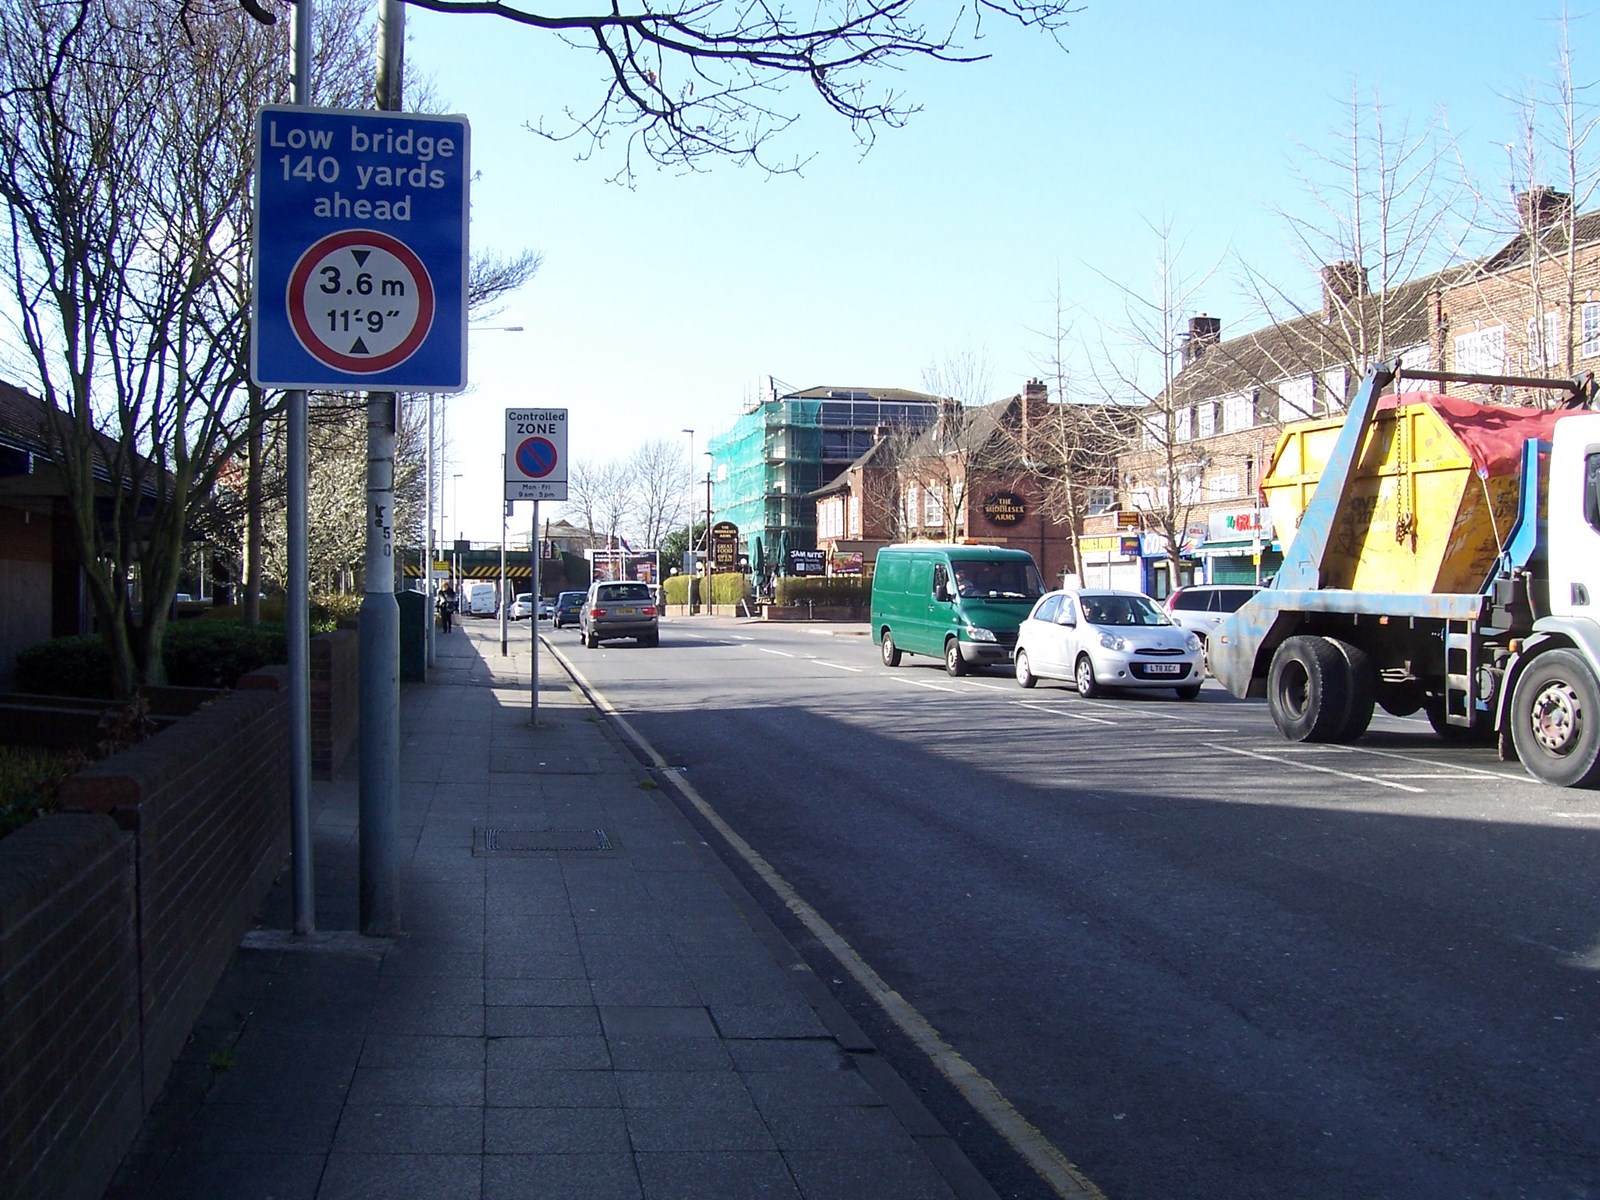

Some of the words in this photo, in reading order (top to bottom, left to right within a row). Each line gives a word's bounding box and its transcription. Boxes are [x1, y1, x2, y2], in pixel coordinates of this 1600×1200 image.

[269, 120, 334, 150] Low
[350, 125, 455, 162] bridge
[279, 154, 340, 184] 140
[356, 162, 446, 190] yards
[313, 191, 412, 221] ahead
[319, 265, 373, 296] 3.6
[381, 278, 405, 297] m
[508, 411, 565, 421] Controlled
[516, 423, 557, 435] ZONE
[995, 513, 1016, 521] ARMS
[790, 550, 806, 558] JAM
